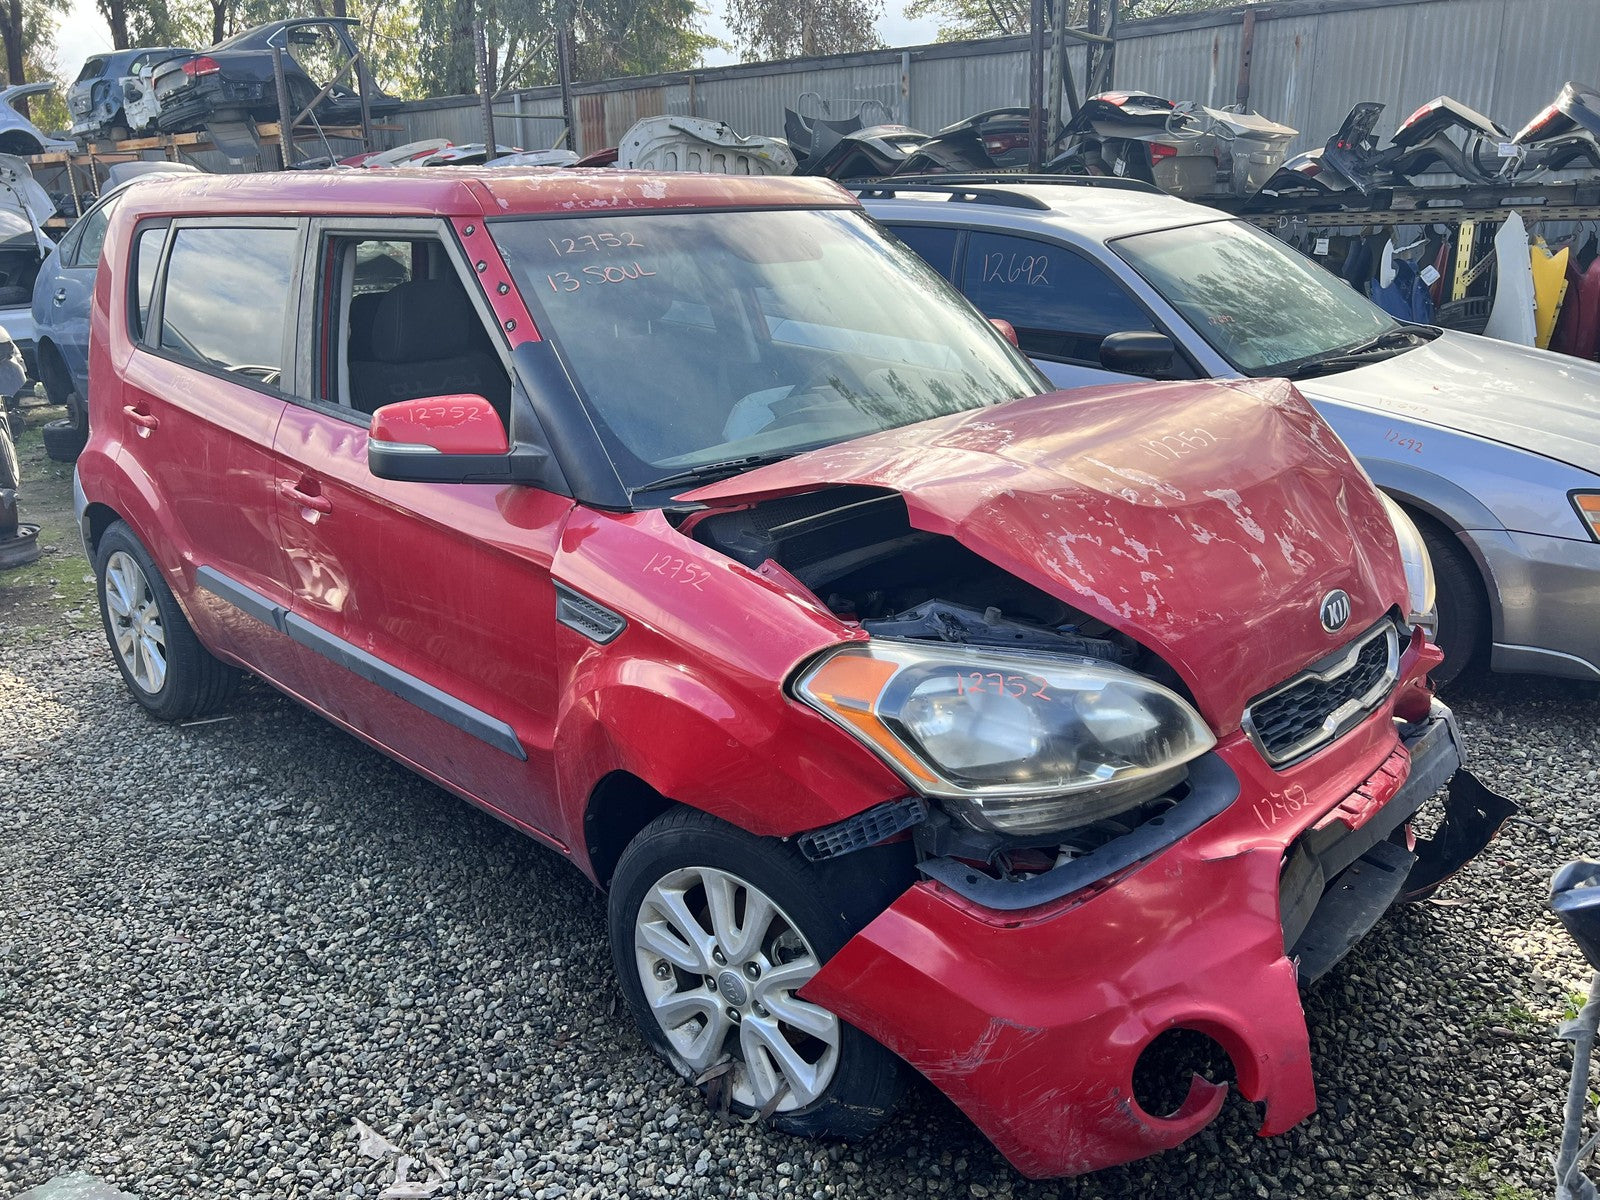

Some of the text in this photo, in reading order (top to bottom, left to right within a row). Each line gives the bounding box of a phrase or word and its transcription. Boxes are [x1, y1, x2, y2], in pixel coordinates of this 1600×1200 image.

[548, 232, 645, 257] 12752
[547, 261, 657, 293] 13 SOUL
[983, 252, 1049, 285] 12692
[408, 406, 482, 422] 12752
[1138, 427, 1231, 460] 12752
[1383, 428, 1424, 454] 12692
[642, 552, 711, 592] 12752
[1326, 596, 1350, 627] KIA
[957, 671, 1052, 701] 12752
